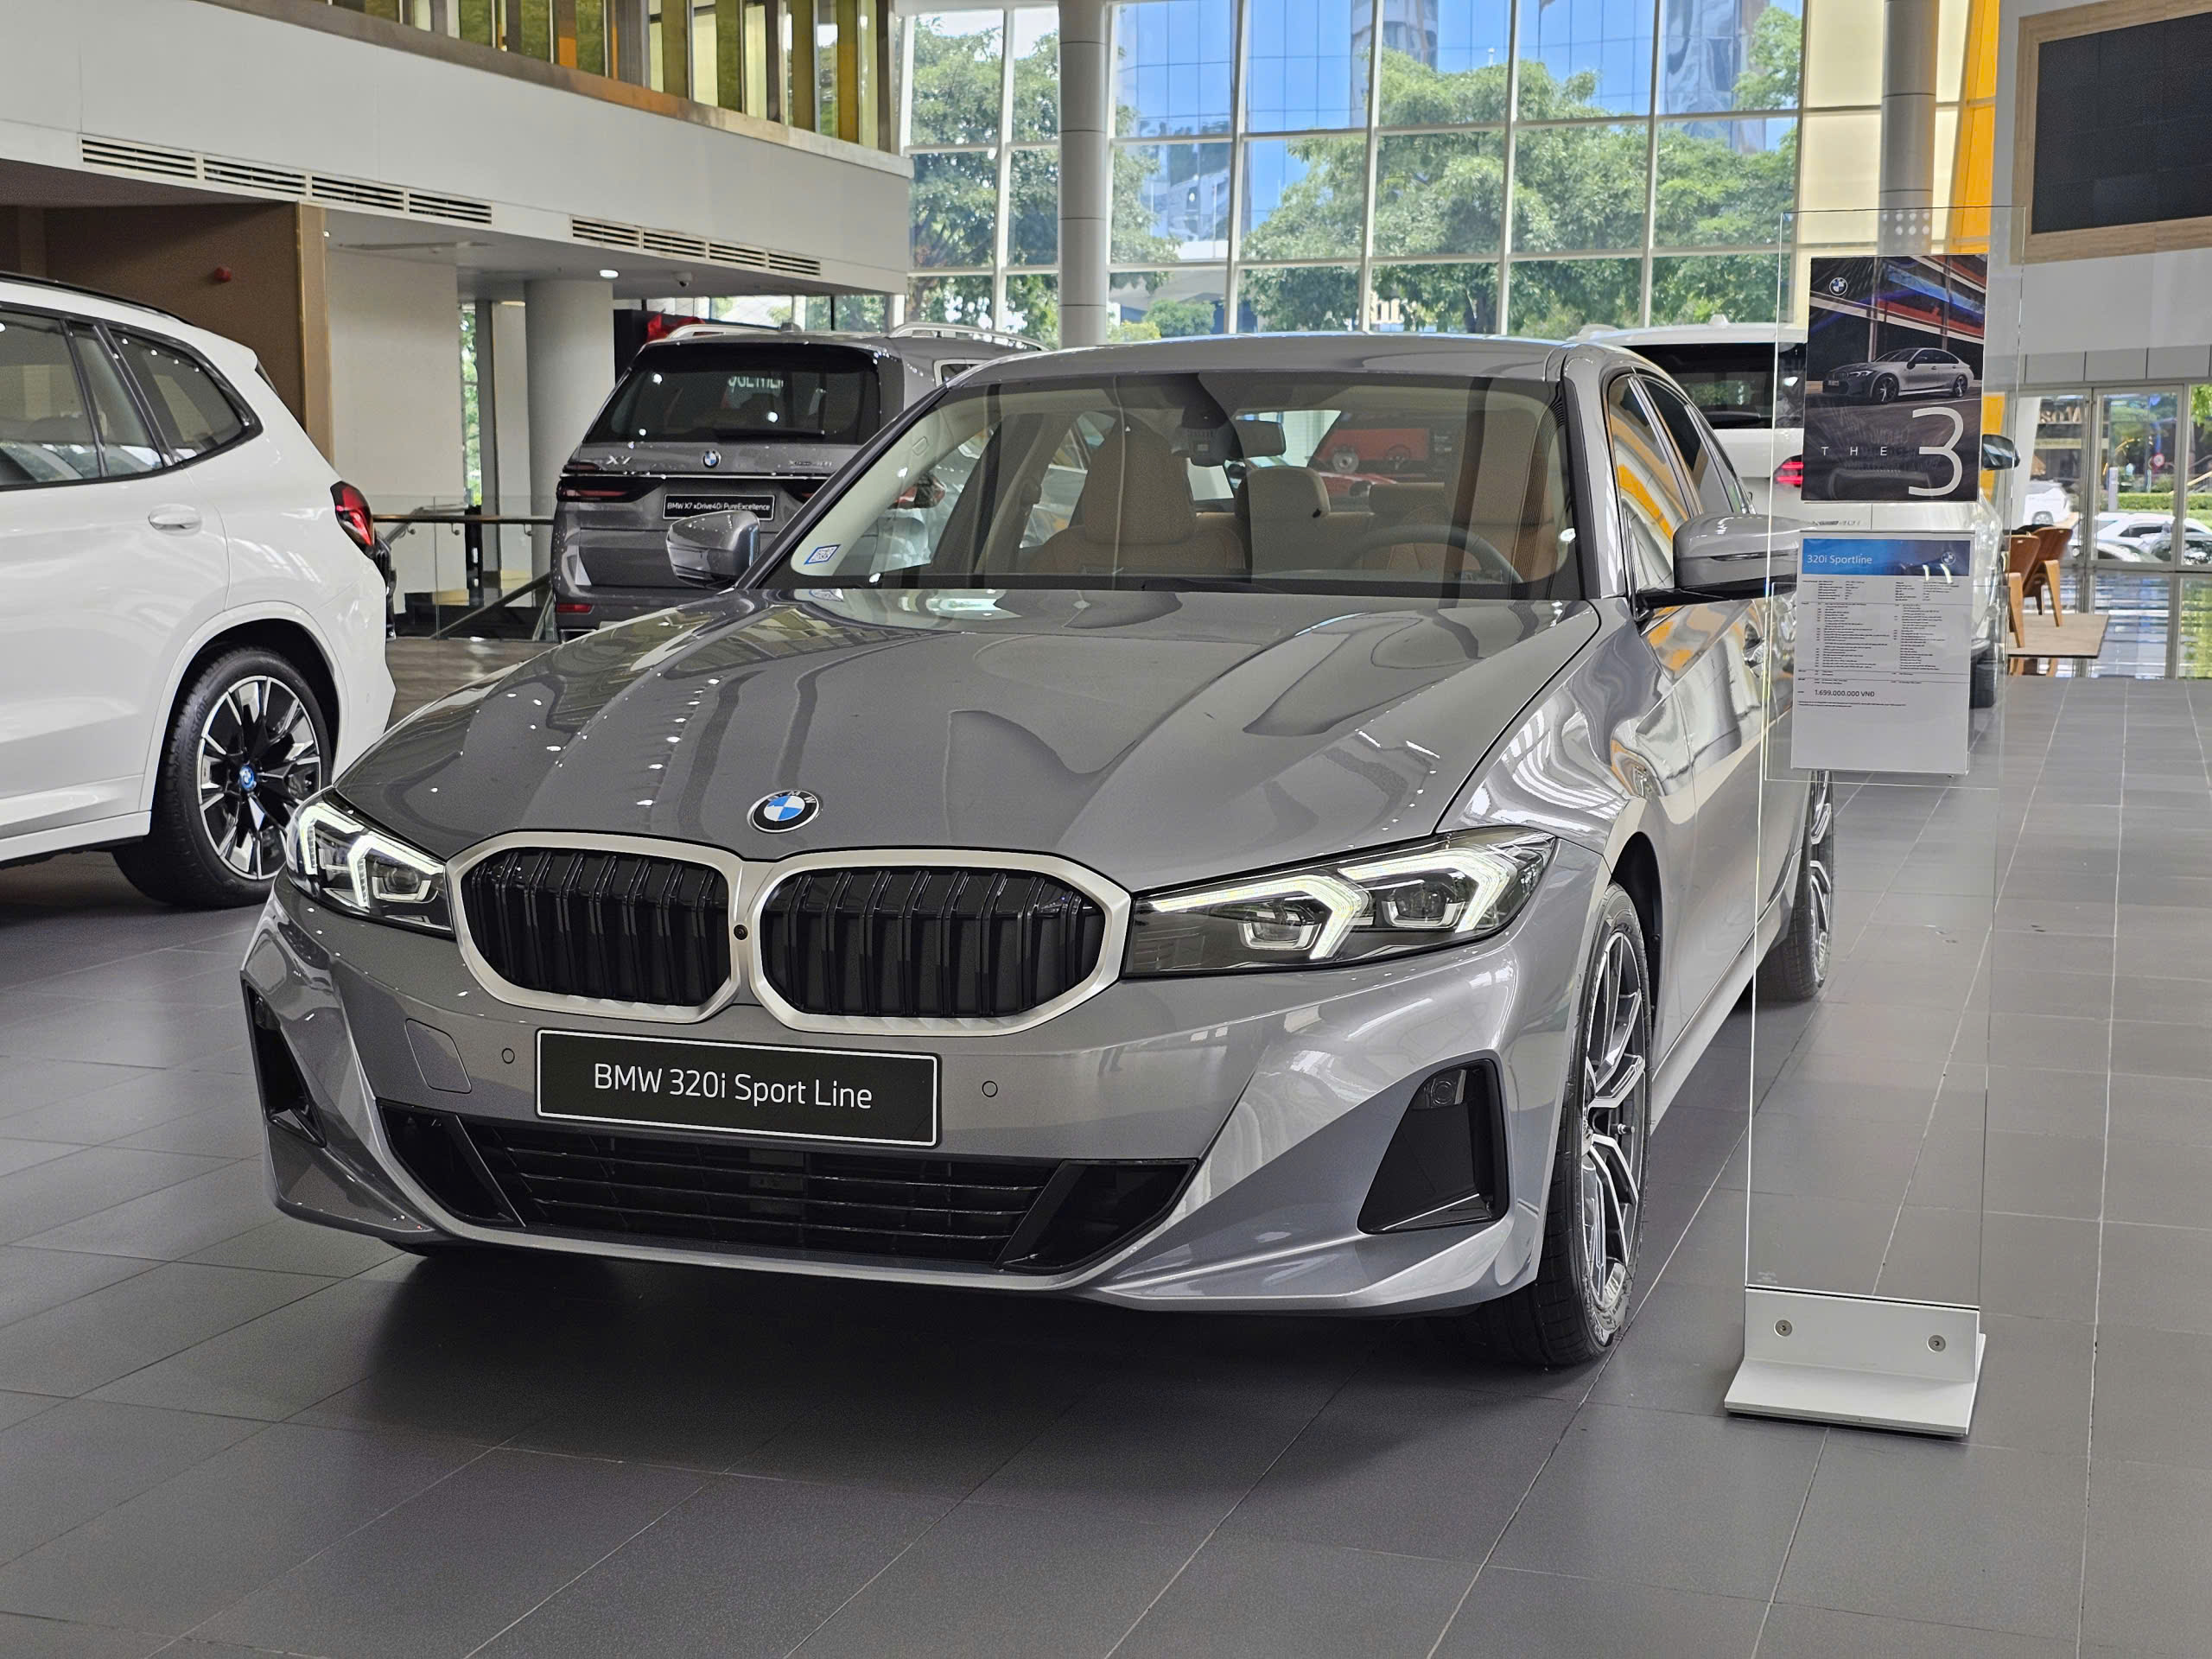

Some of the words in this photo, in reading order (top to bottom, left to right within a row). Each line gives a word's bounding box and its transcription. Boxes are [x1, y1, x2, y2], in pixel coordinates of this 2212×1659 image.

[1821, 447, 1888, 456] THE
[1908, 406, 1964, 496] 3
[724, 503, 770, 512] PureExcellence
[1807, 554, 1827, 563] 320i
[1829, 553, 1872, 566] Sportline
[594, 1063, 662, 1094] BMW
[670, 1069, 727, 1099] 320i
[734, 1073, 806, 1107] Sport
[815, 1079, 873, 1109] Line
